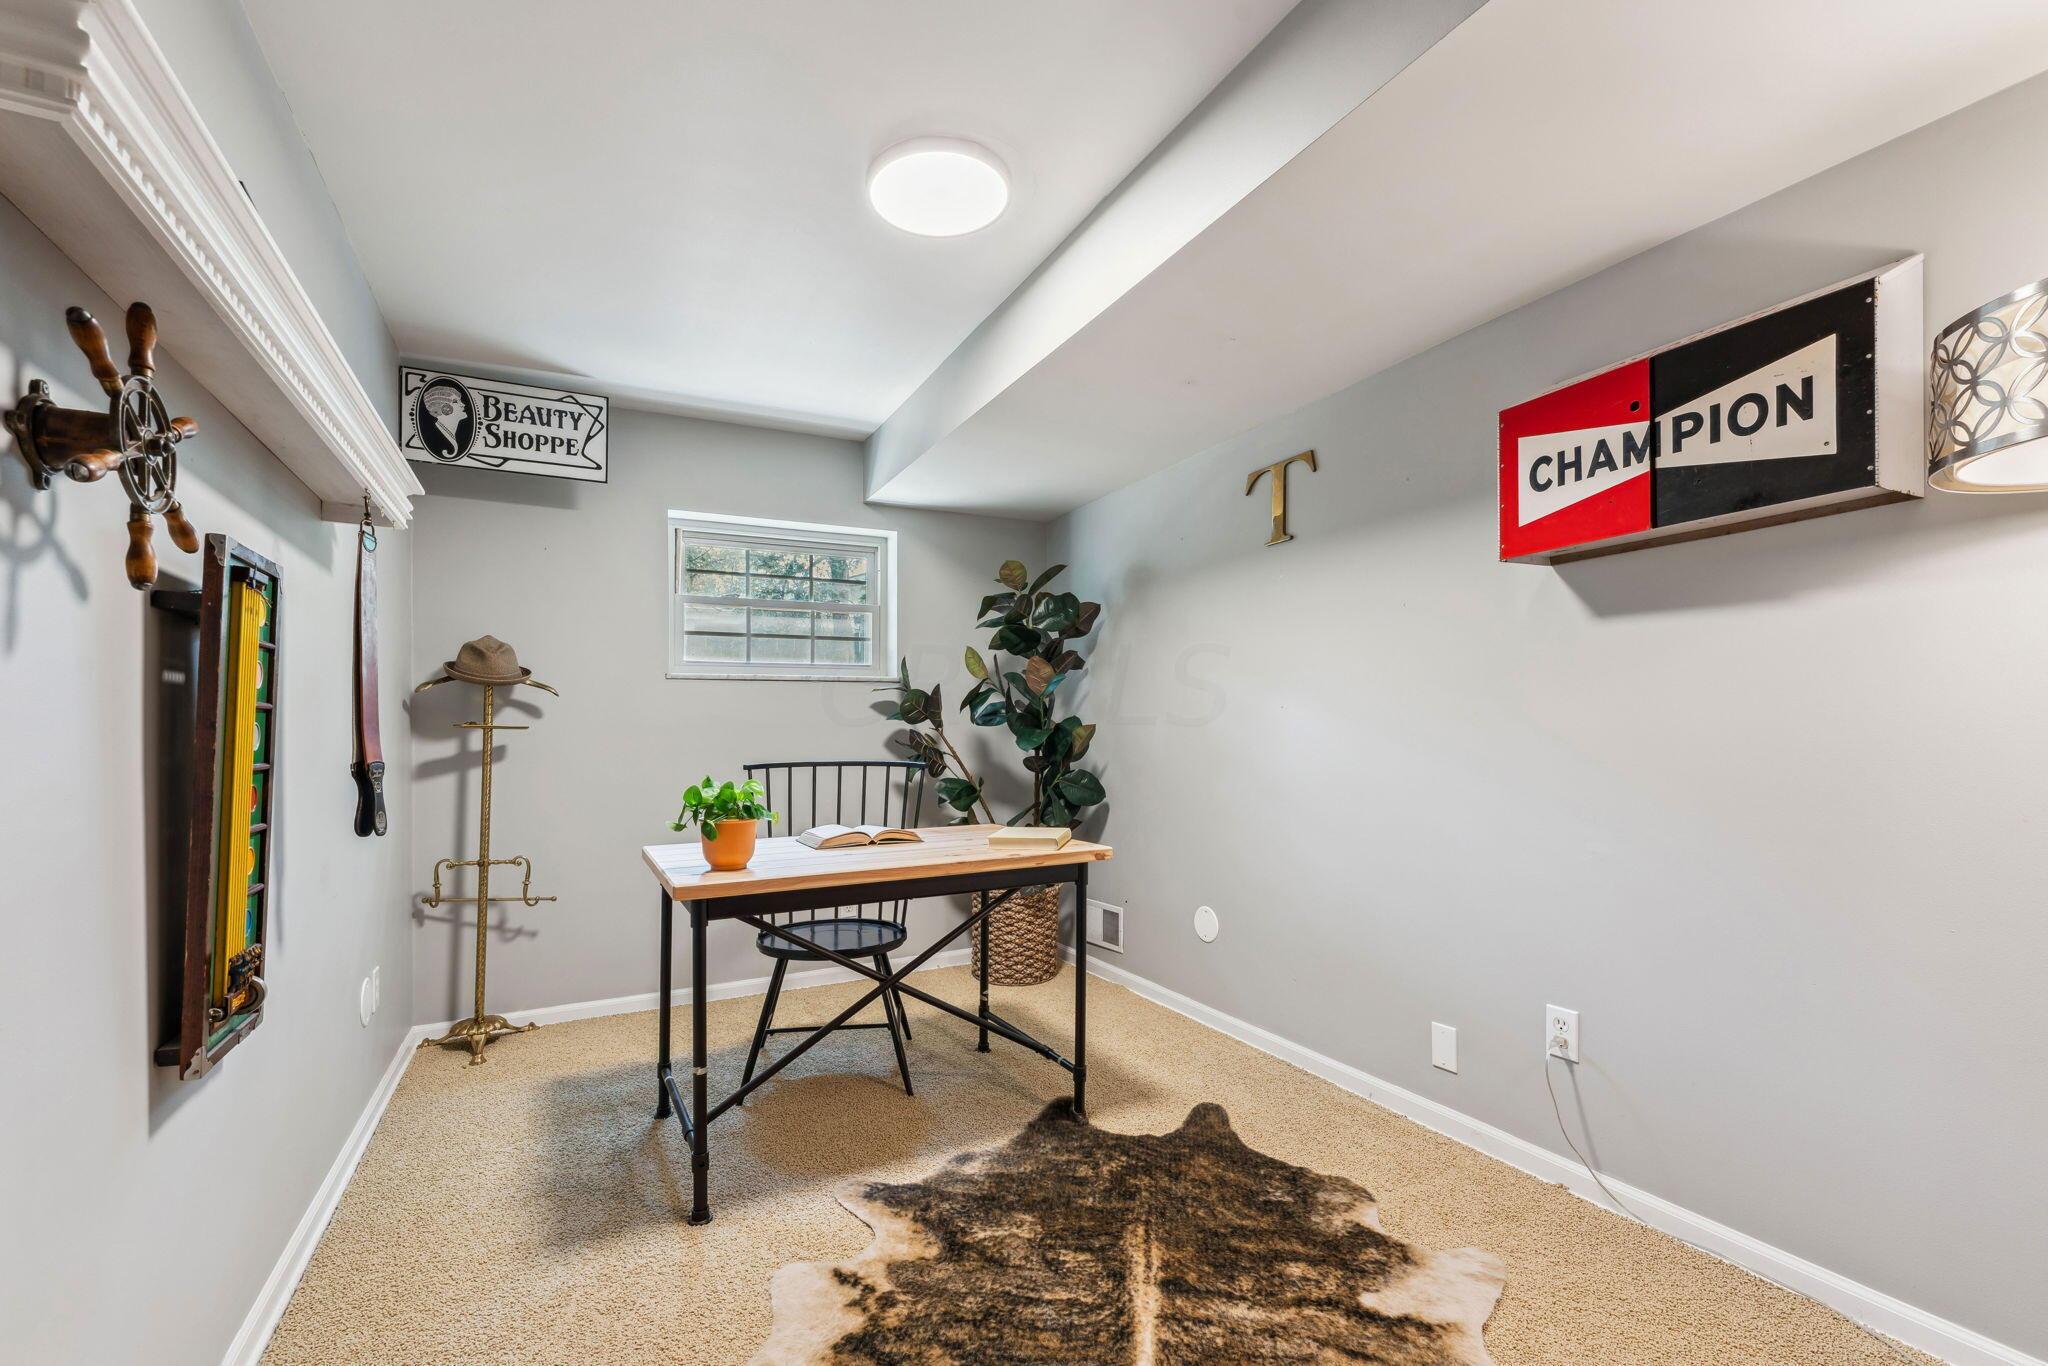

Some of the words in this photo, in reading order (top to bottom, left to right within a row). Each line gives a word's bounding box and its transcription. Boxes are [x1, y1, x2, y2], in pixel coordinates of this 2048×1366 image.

[479, 393, 586, 431] BEAUTY
[482, 423, 580, 456] SHOPPE
[1529, 376, 1814, 493] CHAMPION
[1244, 449, 1318, 547] T
